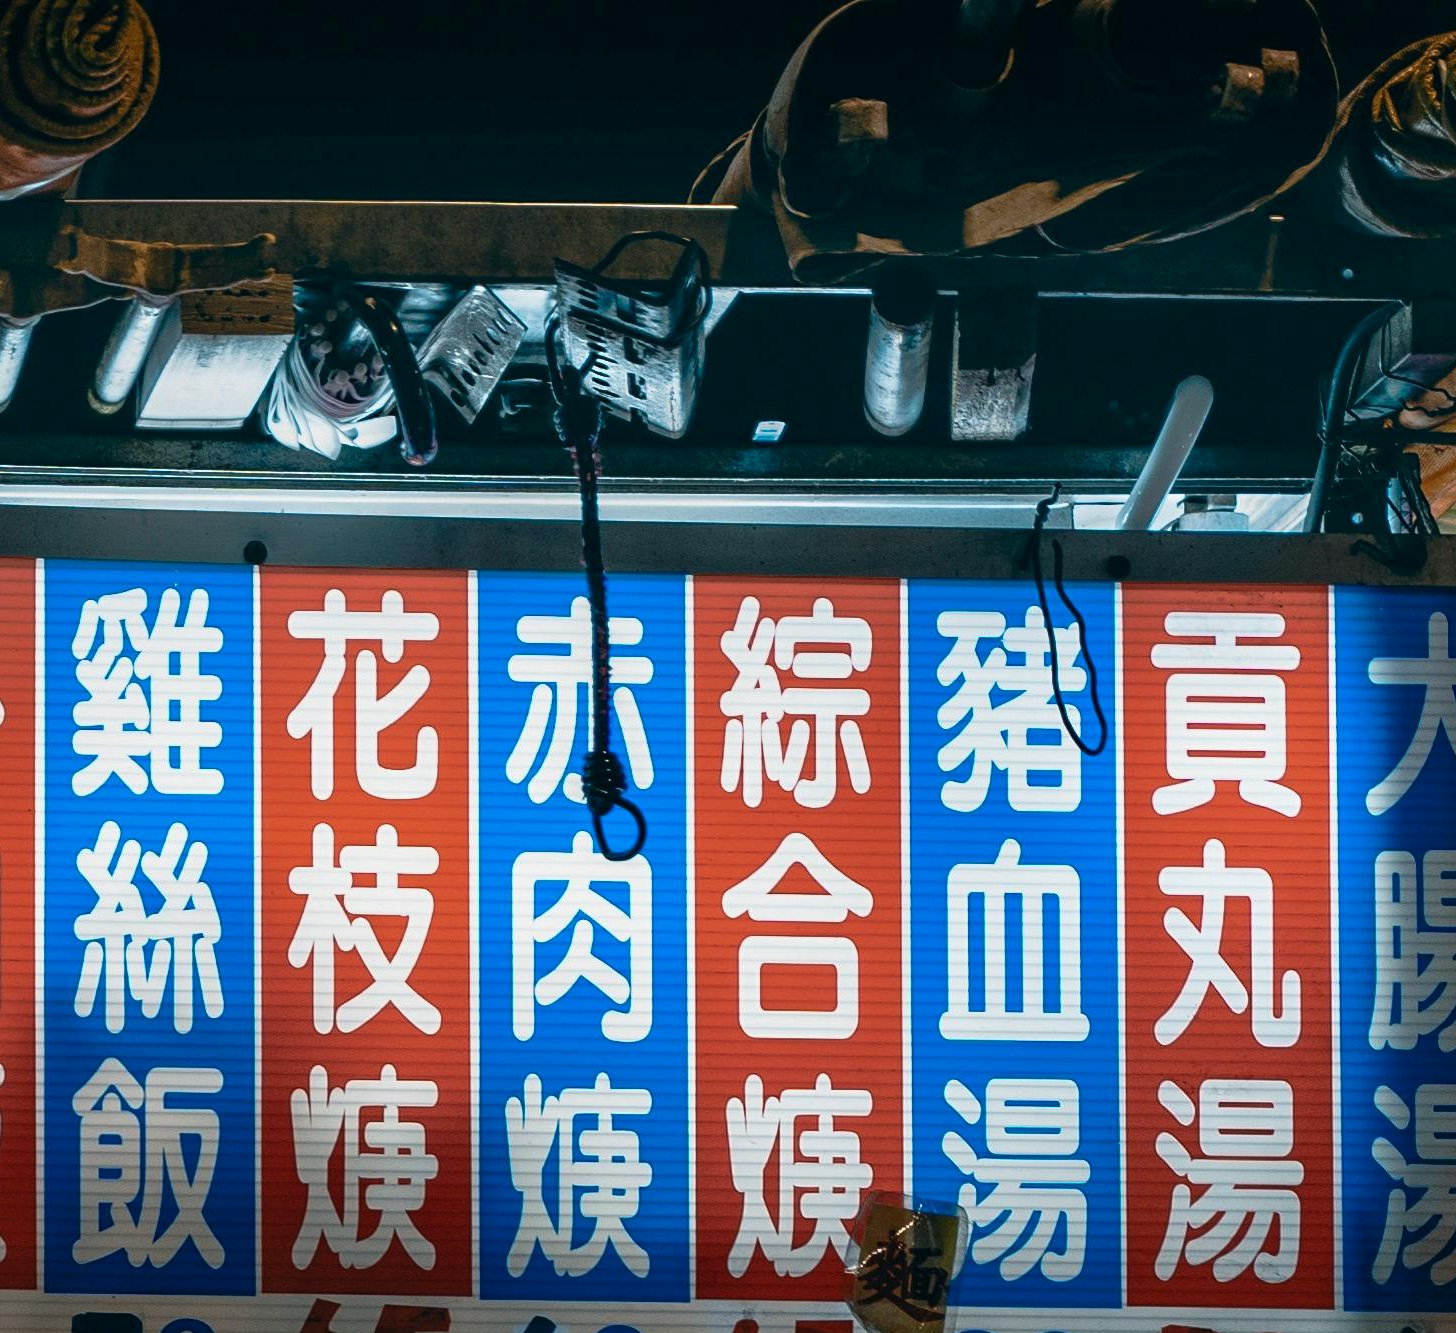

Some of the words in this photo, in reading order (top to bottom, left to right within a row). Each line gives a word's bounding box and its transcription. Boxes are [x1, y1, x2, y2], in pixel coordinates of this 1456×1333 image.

[71, 588, 225, 1269] 雞絲飯
[285, 588, 443, 1272] 花枝焿
[504, 595, 654, 1278] 赤肉焿
[718, 595, 875, 1279] 綜合焿
[936, 604, 1092, 1282] 豬血湯
[1149, 609, 1305, 1285] 貢丸湯
[855, 1228, 950, 1323] 麵
